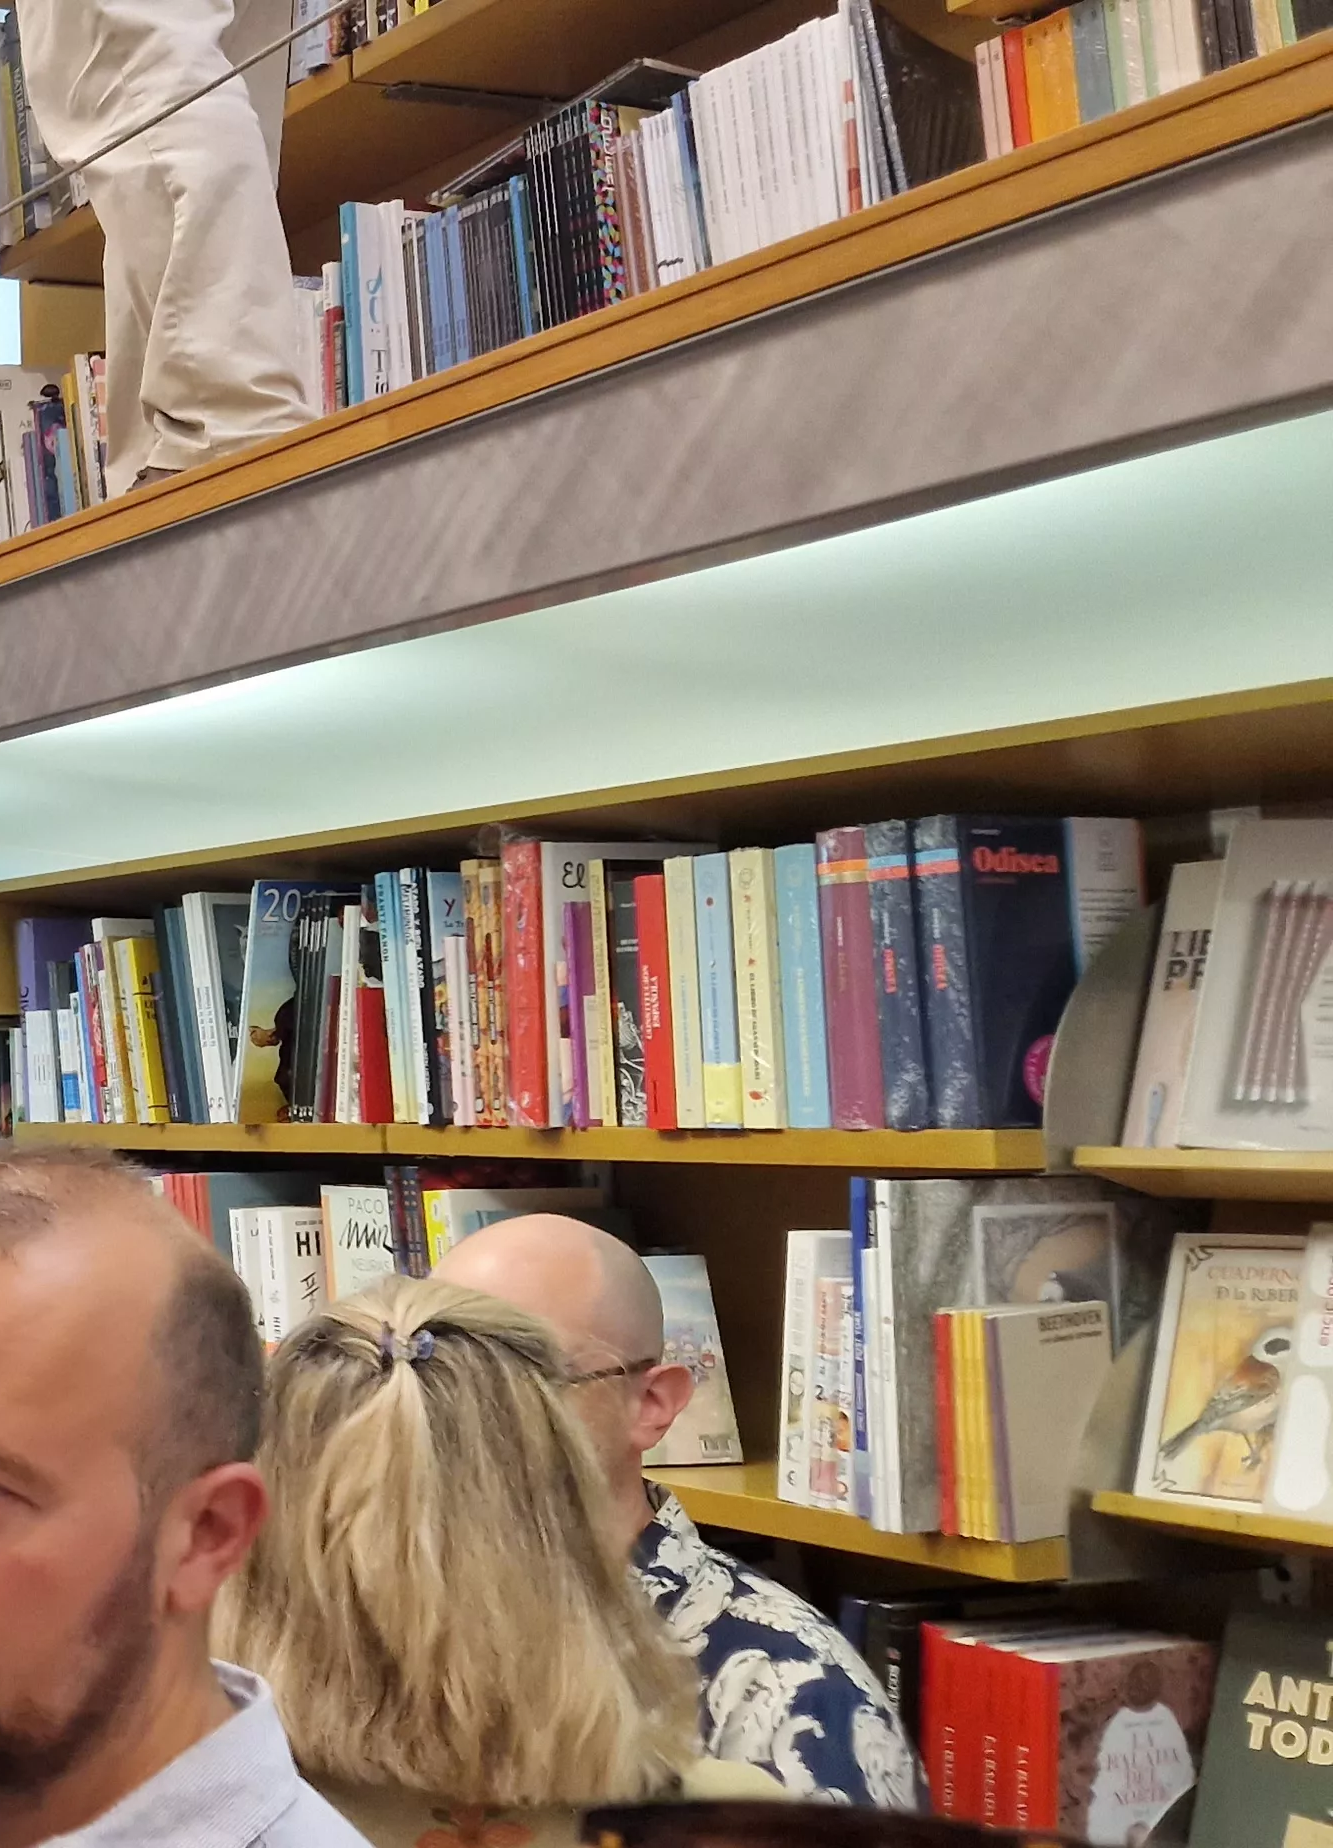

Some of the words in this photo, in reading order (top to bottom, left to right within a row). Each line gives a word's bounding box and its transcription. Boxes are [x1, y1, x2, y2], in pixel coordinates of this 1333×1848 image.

[972, 847, 1060, 873] Odisea
[562, 861, 587, 889] El
[348, 1197, 383, 1214] PACO
